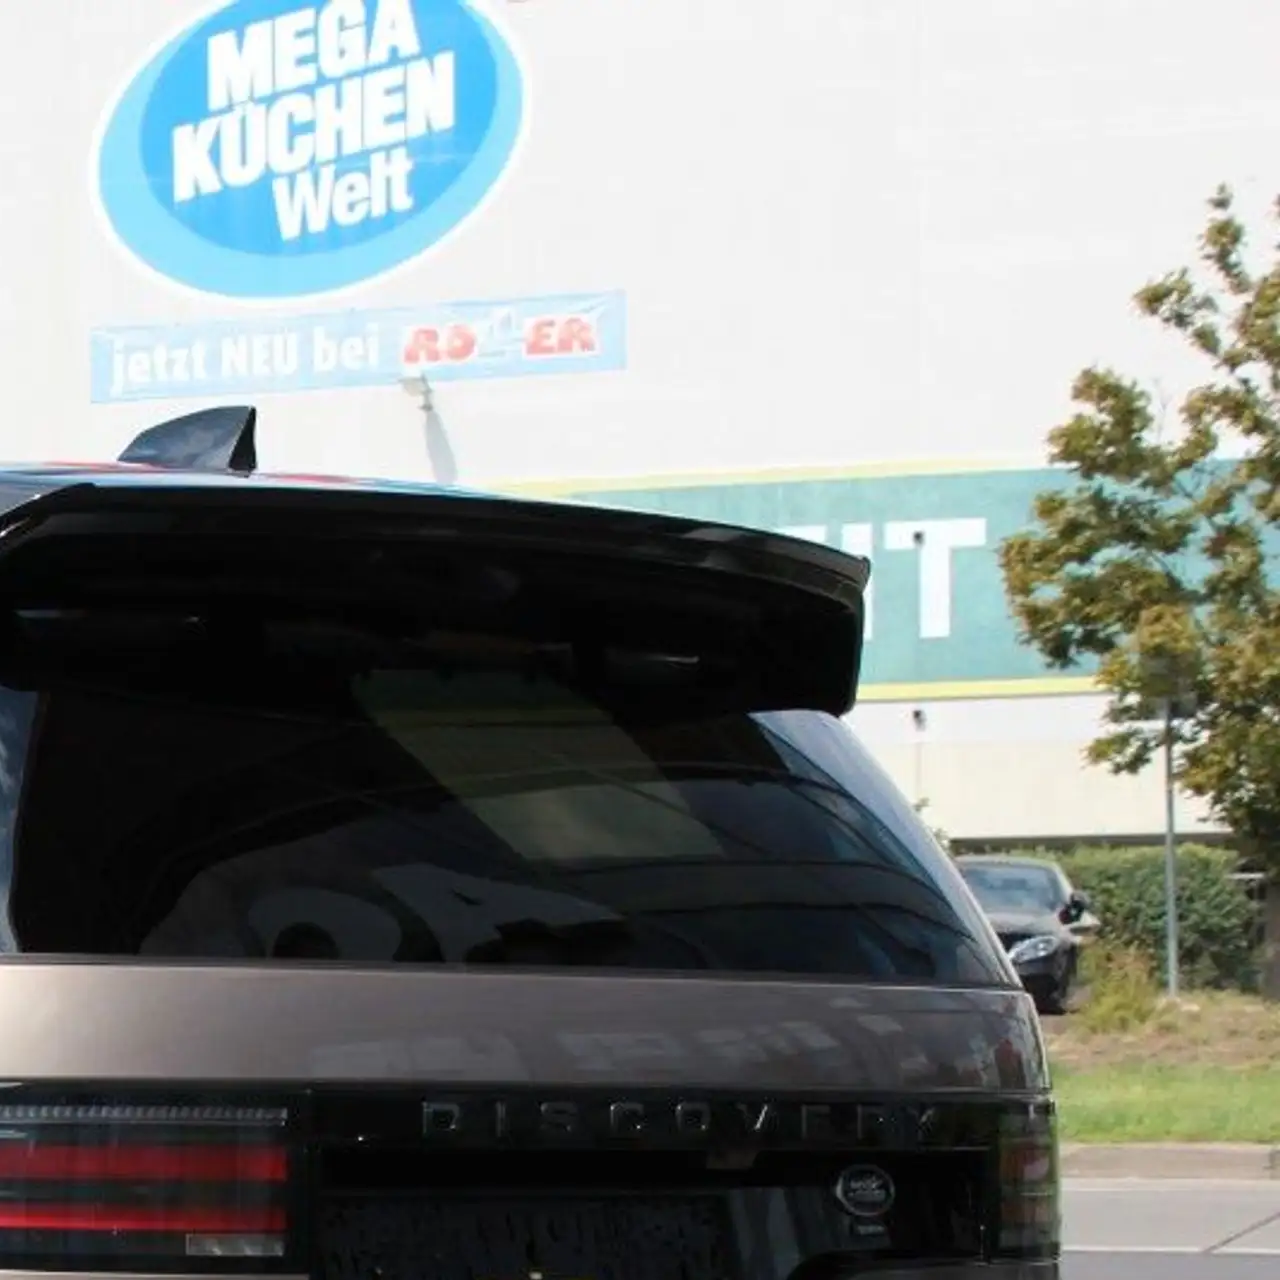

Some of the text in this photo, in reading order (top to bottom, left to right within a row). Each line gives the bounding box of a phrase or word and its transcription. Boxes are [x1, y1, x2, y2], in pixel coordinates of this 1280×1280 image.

[207, 0, 420, 111] MEGA
[173, 51, 455, 203] KÜCHEN
[273, 147, 414, 242] Welt
[110, 315, 597, 396] jetzt NEU bei ROER
